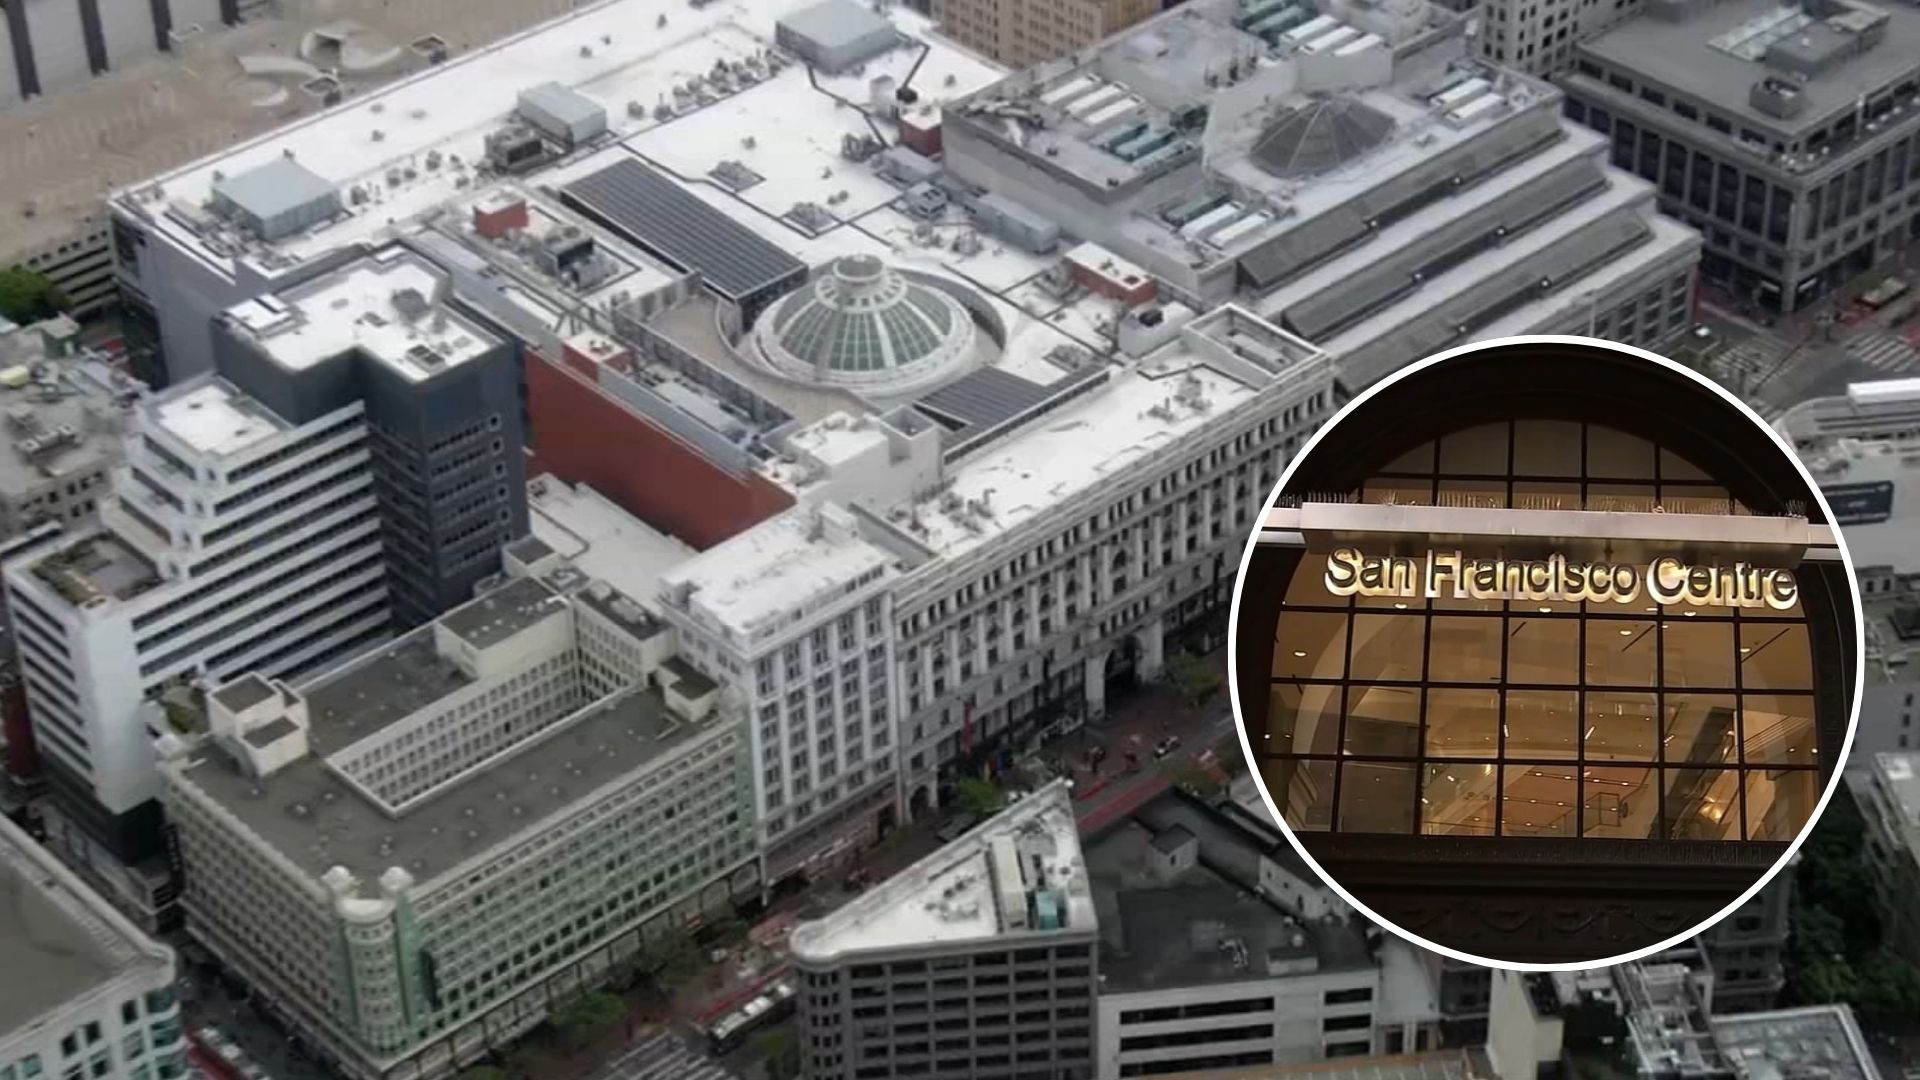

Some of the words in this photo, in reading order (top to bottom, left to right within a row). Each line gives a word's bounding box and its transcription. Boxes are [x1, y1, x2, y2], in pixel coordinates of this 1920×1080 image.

[1323, 548, 1416, 597] San
[1425, 548, 1640, 603] Francisco
[1647, 556, 1798, 609] Centre
